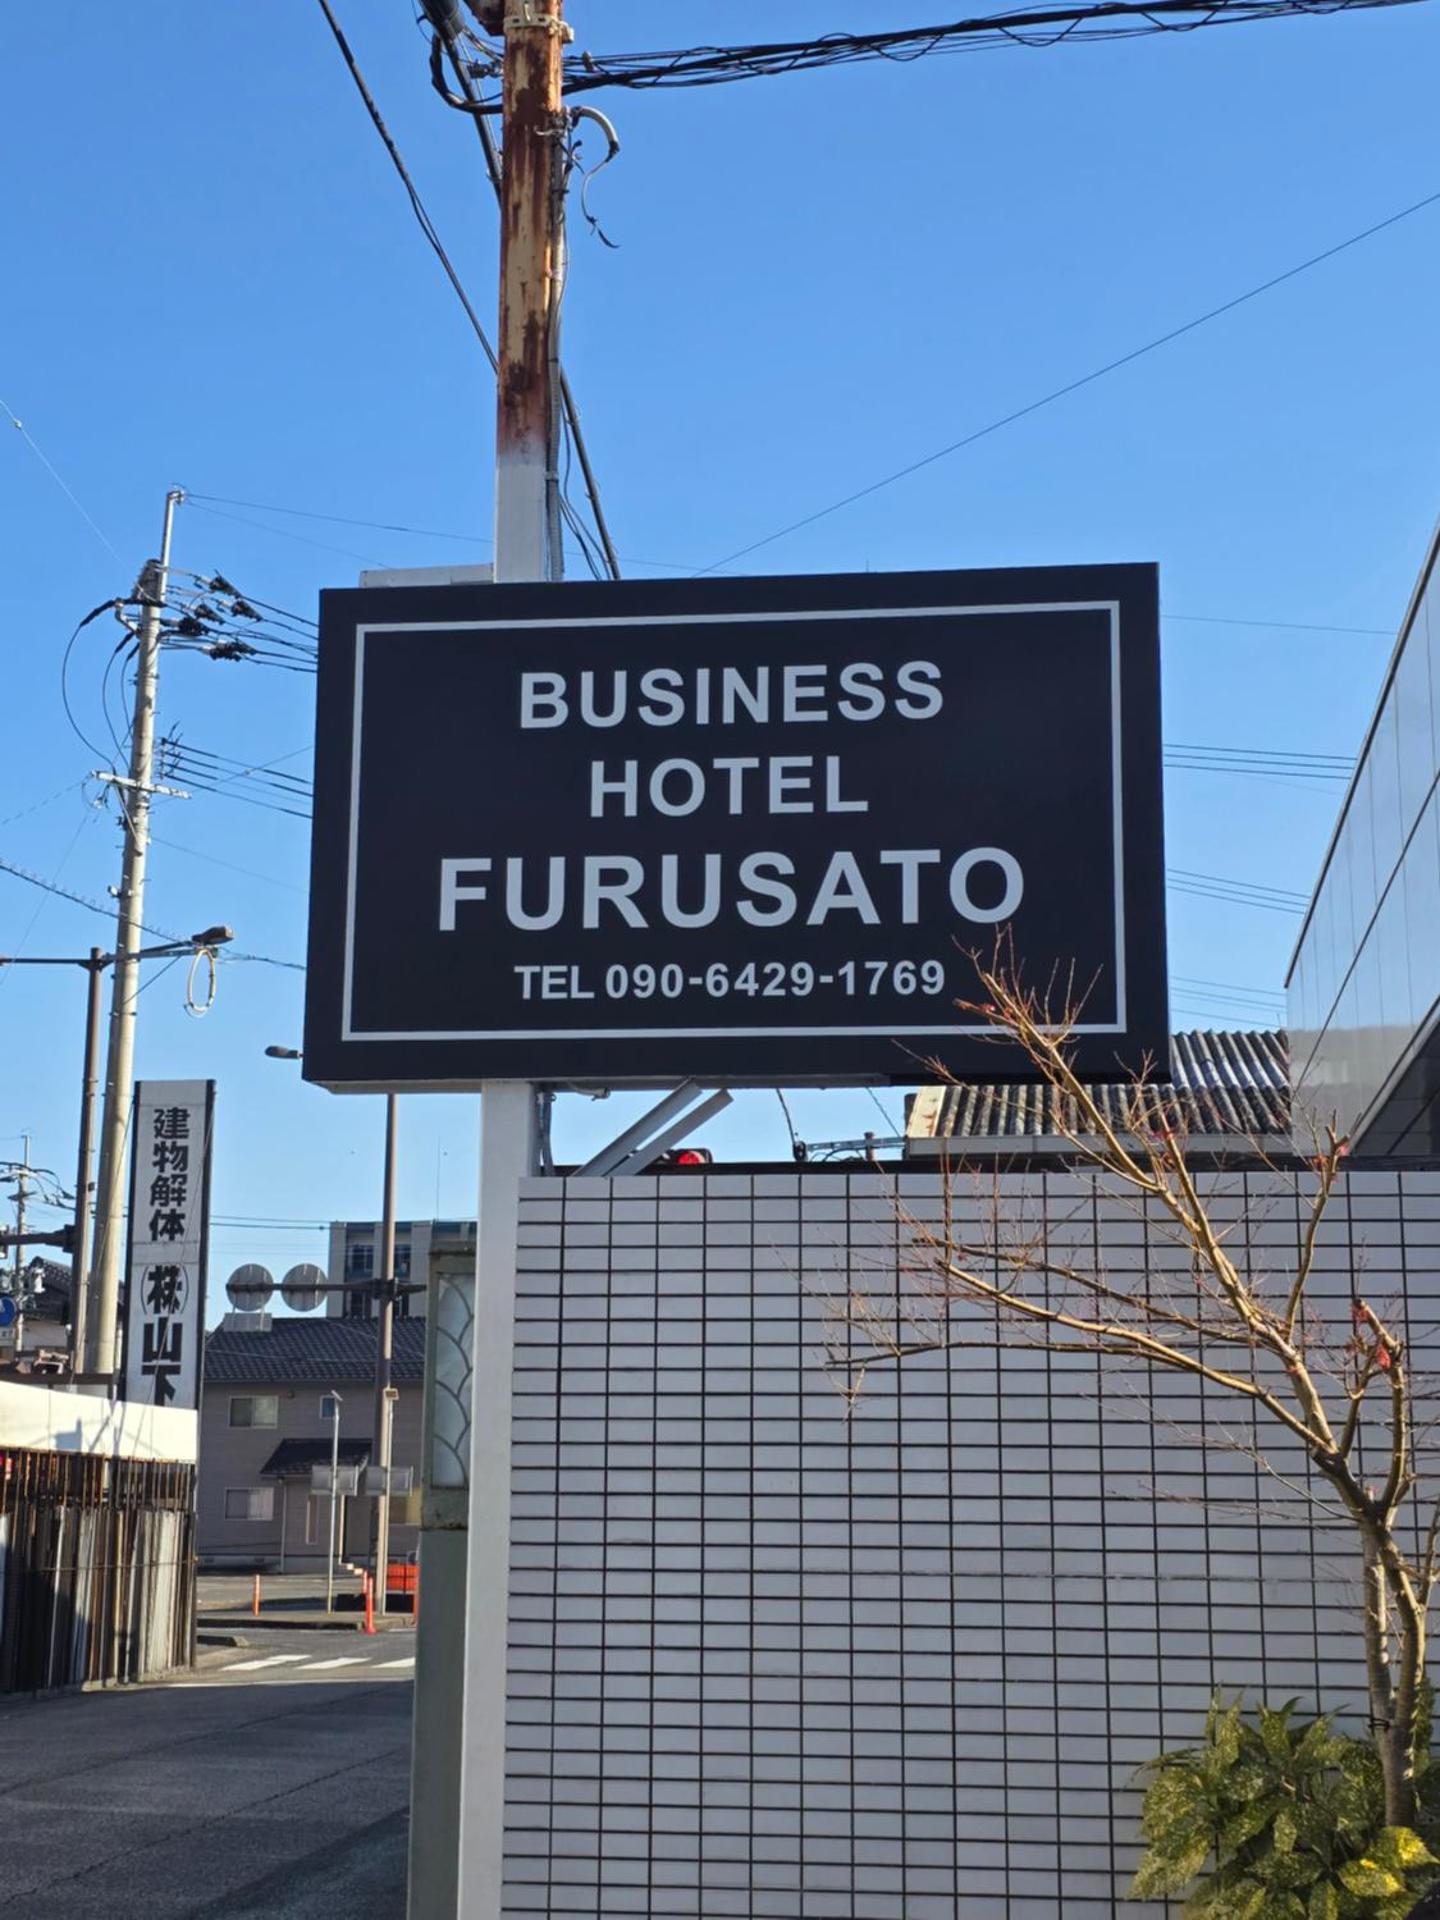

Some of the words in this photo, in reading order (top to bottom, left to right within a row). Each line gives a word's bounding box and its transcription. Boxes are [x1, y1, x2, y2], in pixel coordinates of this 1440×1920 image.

[519, 660, 944, 730] BUSINESS
[590, 755, 869, 818] HOTEL
[438, 847, 1025, 932] FURUSATO
[514, 965, 596, 1000] TEL
[605, 959, 947, 999] 090-6429-1769
[149, 1106, 190, 1241] 建物解体
